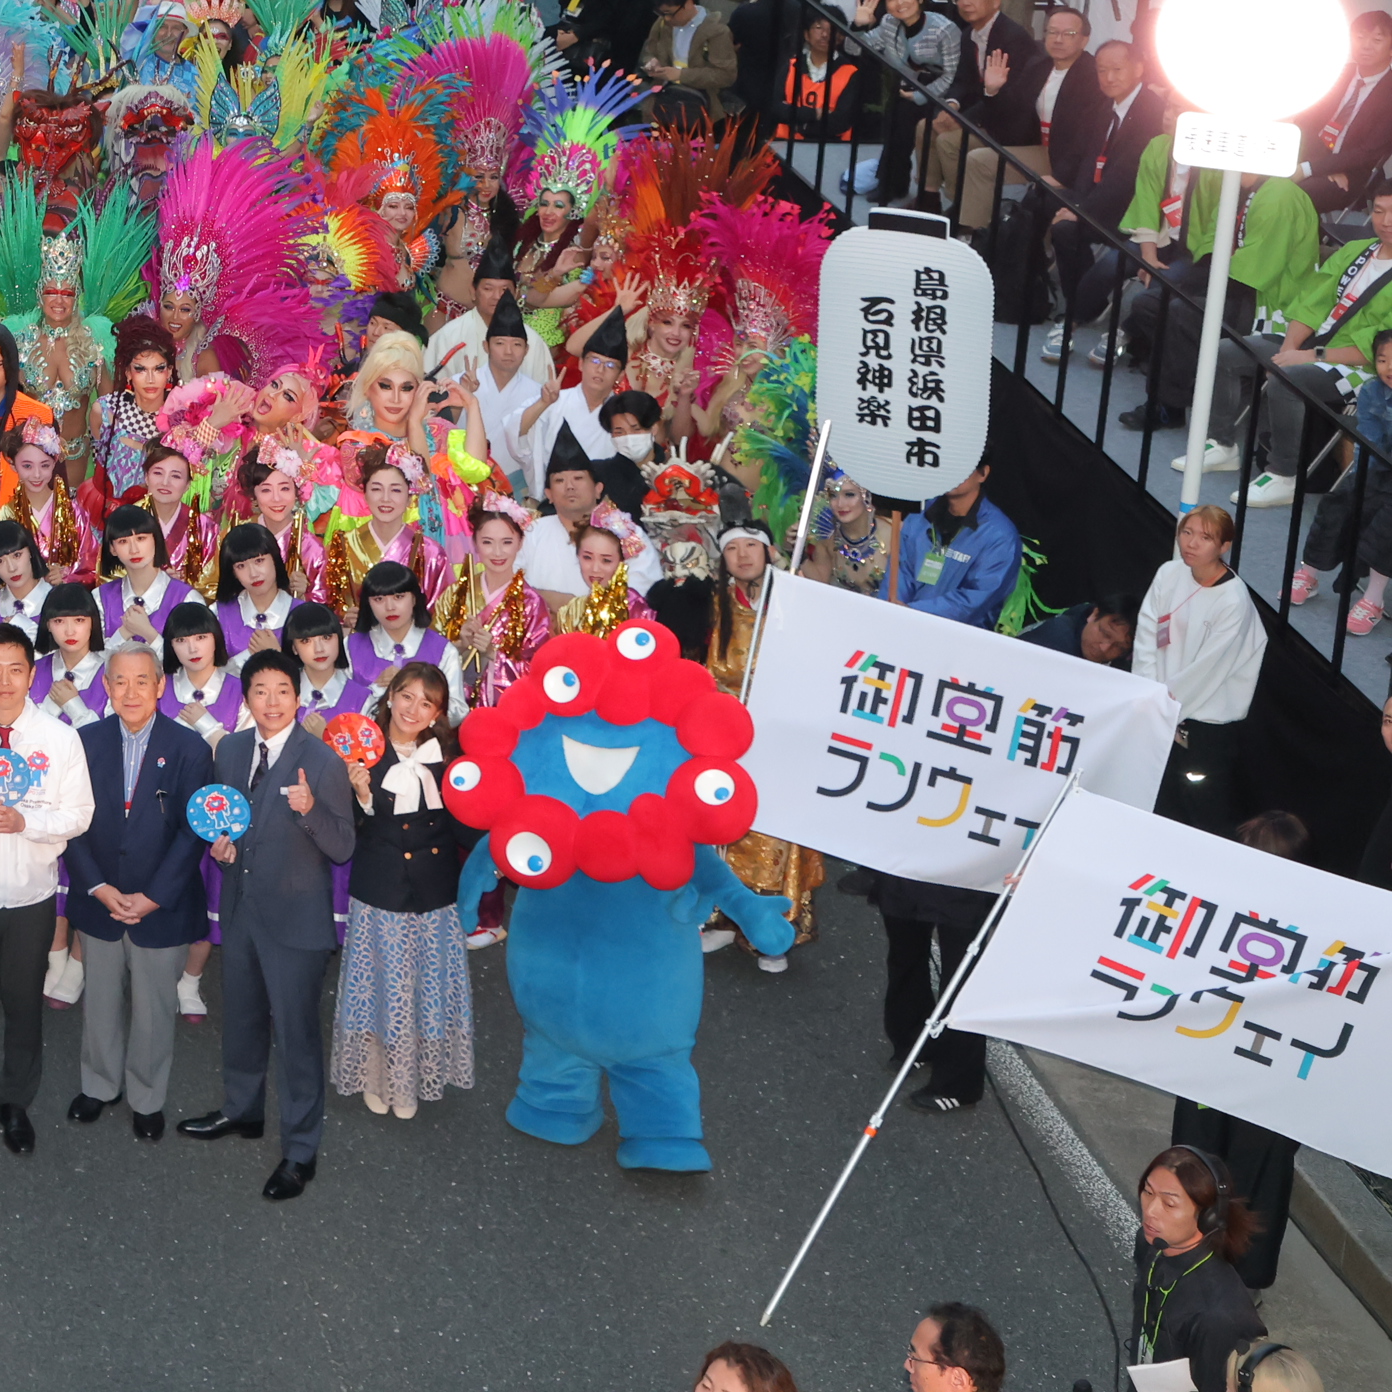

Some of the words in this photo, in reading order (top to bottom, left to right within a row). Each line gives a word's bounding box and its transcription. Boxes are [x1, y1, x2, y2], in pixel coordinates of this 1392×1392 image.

[856, 296, 896, 427] 石見神楽
[904, 267, 949, 468] 島根県浜田市
[839, 650, 1085, 774] 御堂筋
[1114, 873, 1389, 1006] 御堂筋
